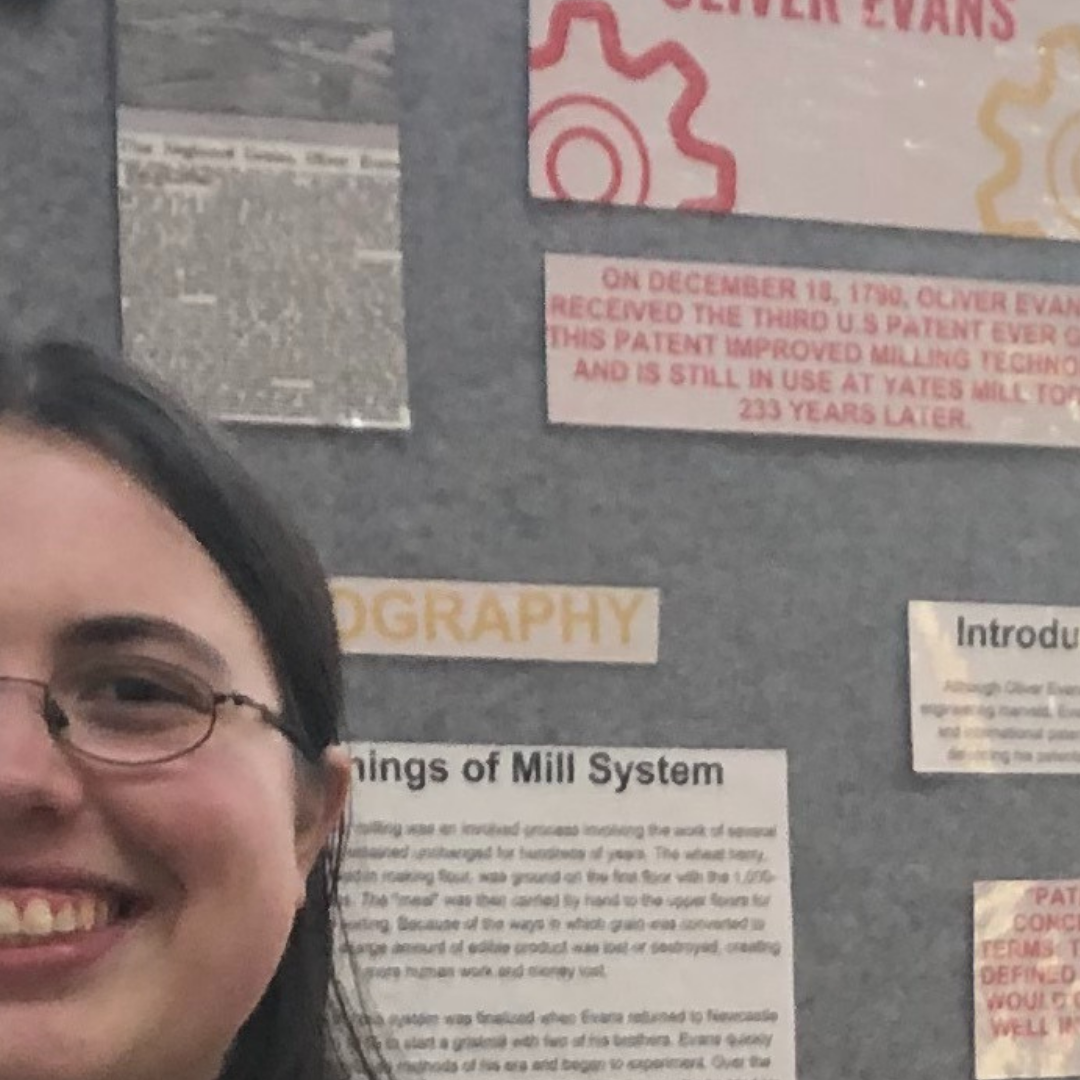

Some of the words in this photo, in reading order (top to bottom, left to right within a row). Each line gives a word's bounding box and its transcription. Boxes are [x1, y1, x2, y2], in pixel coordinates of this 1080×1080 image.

[602, 266, 639, 291] ON
[648, 270, 797, 300] DECEMBER
[917, 284, 1007, 313] OLIVER
[549, 296, 684, 324] RECEIVED
[696, 302, 742, 327] THE
[752, 305, 828, 332] THIRD
[886, 314, 983, 341] PATENT
[991, 321, 1056, 346] EVER
[549, 325, 605, 350] THIS
[614, 330, 718, 355] PATENT
[727, 336, 862, 364] IMPROVED
[870, 343, 970, 370] MILLING
[573, 358, 629, 382] AND
[636, 361, 661, 384] IS
[670, 364, 739, 389] STILL
[749, 370, 773, 390] IN
[782, 370, 832, 394] USE
[841, 373, 875, 395] AT
[883, 376, 964, 401] YATES
[971, 381, 1027, 404] MILL
[739, 398, 781, 421] 233
[789, 400, 877, 427] YEARS
[883, 406, 972, 430] LATER.
[957, 615, 1080, 649] Introdu
[463, 751, 500, 784] of
[511, 751, 575, 786] Mill
[588, 752, 724, 793] System
